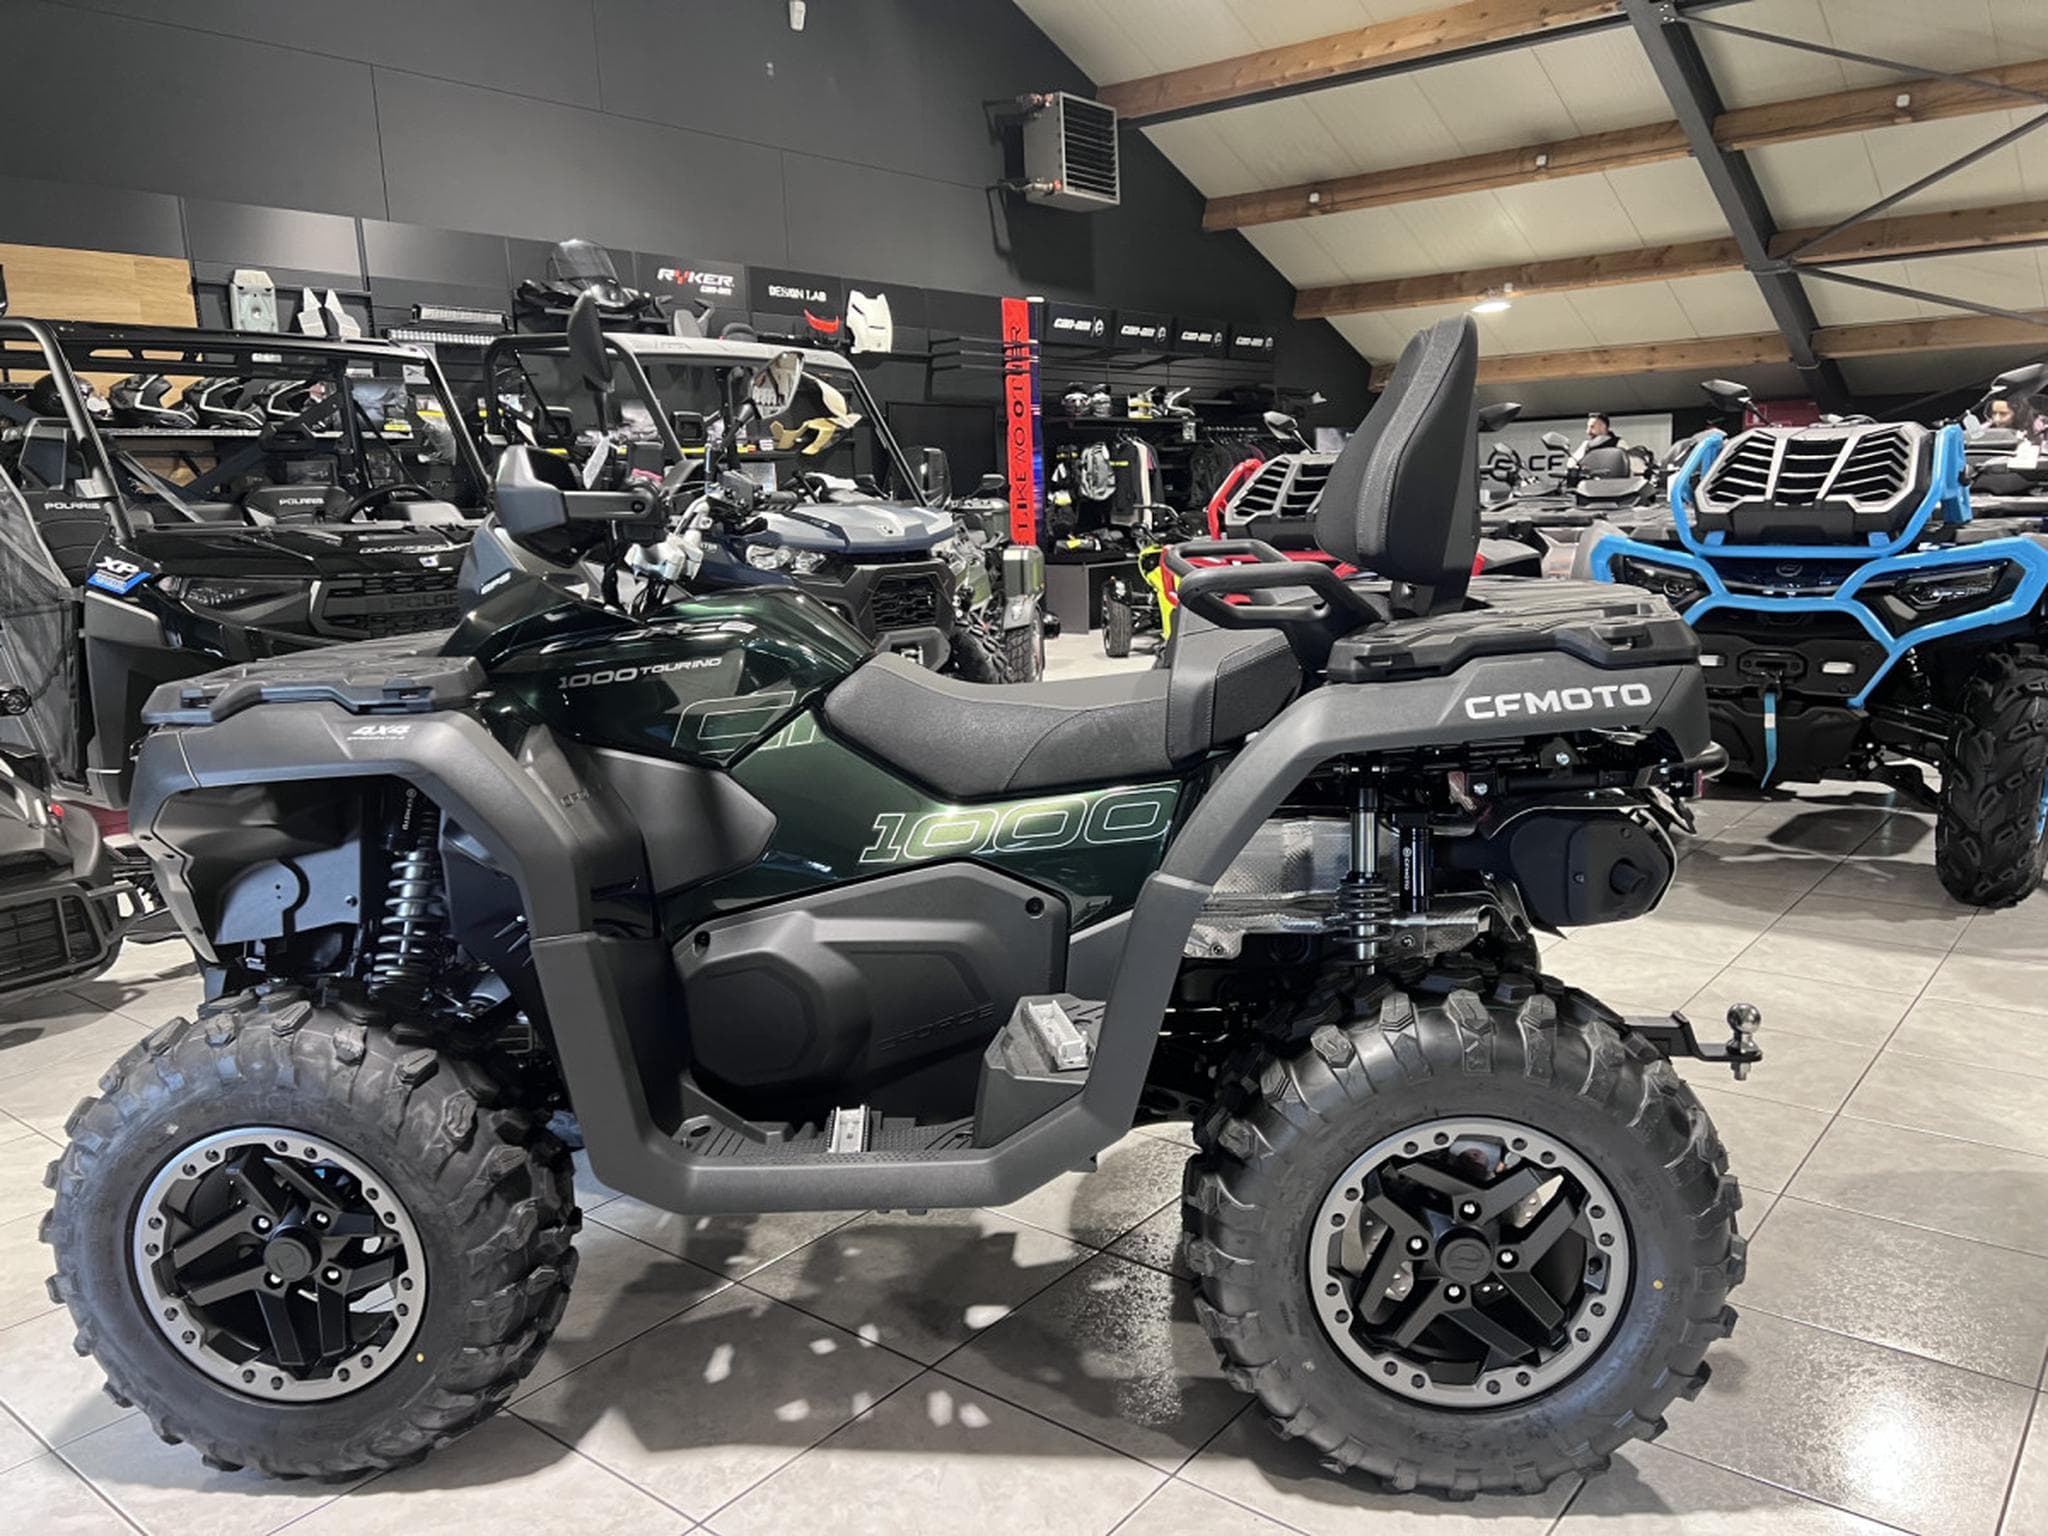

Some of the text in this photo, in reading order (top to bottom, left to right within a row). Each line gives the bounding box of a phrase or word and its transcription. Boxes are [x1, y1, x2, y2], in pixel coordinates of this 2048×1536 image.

[657, 267, 732, 287] RYKER
[768, 285, 827, 302] DESIGN LAB
[1014, 426, 1025, 463] NO
[44, 502, 101, 511] POLARIS
[96, 556, 139, 575] XP
[558, 657, 722, 689] 1000 TOURING
[1465, 683, 1651, 719] CFMOTO
[859, 788, 1177, 863] 1000
